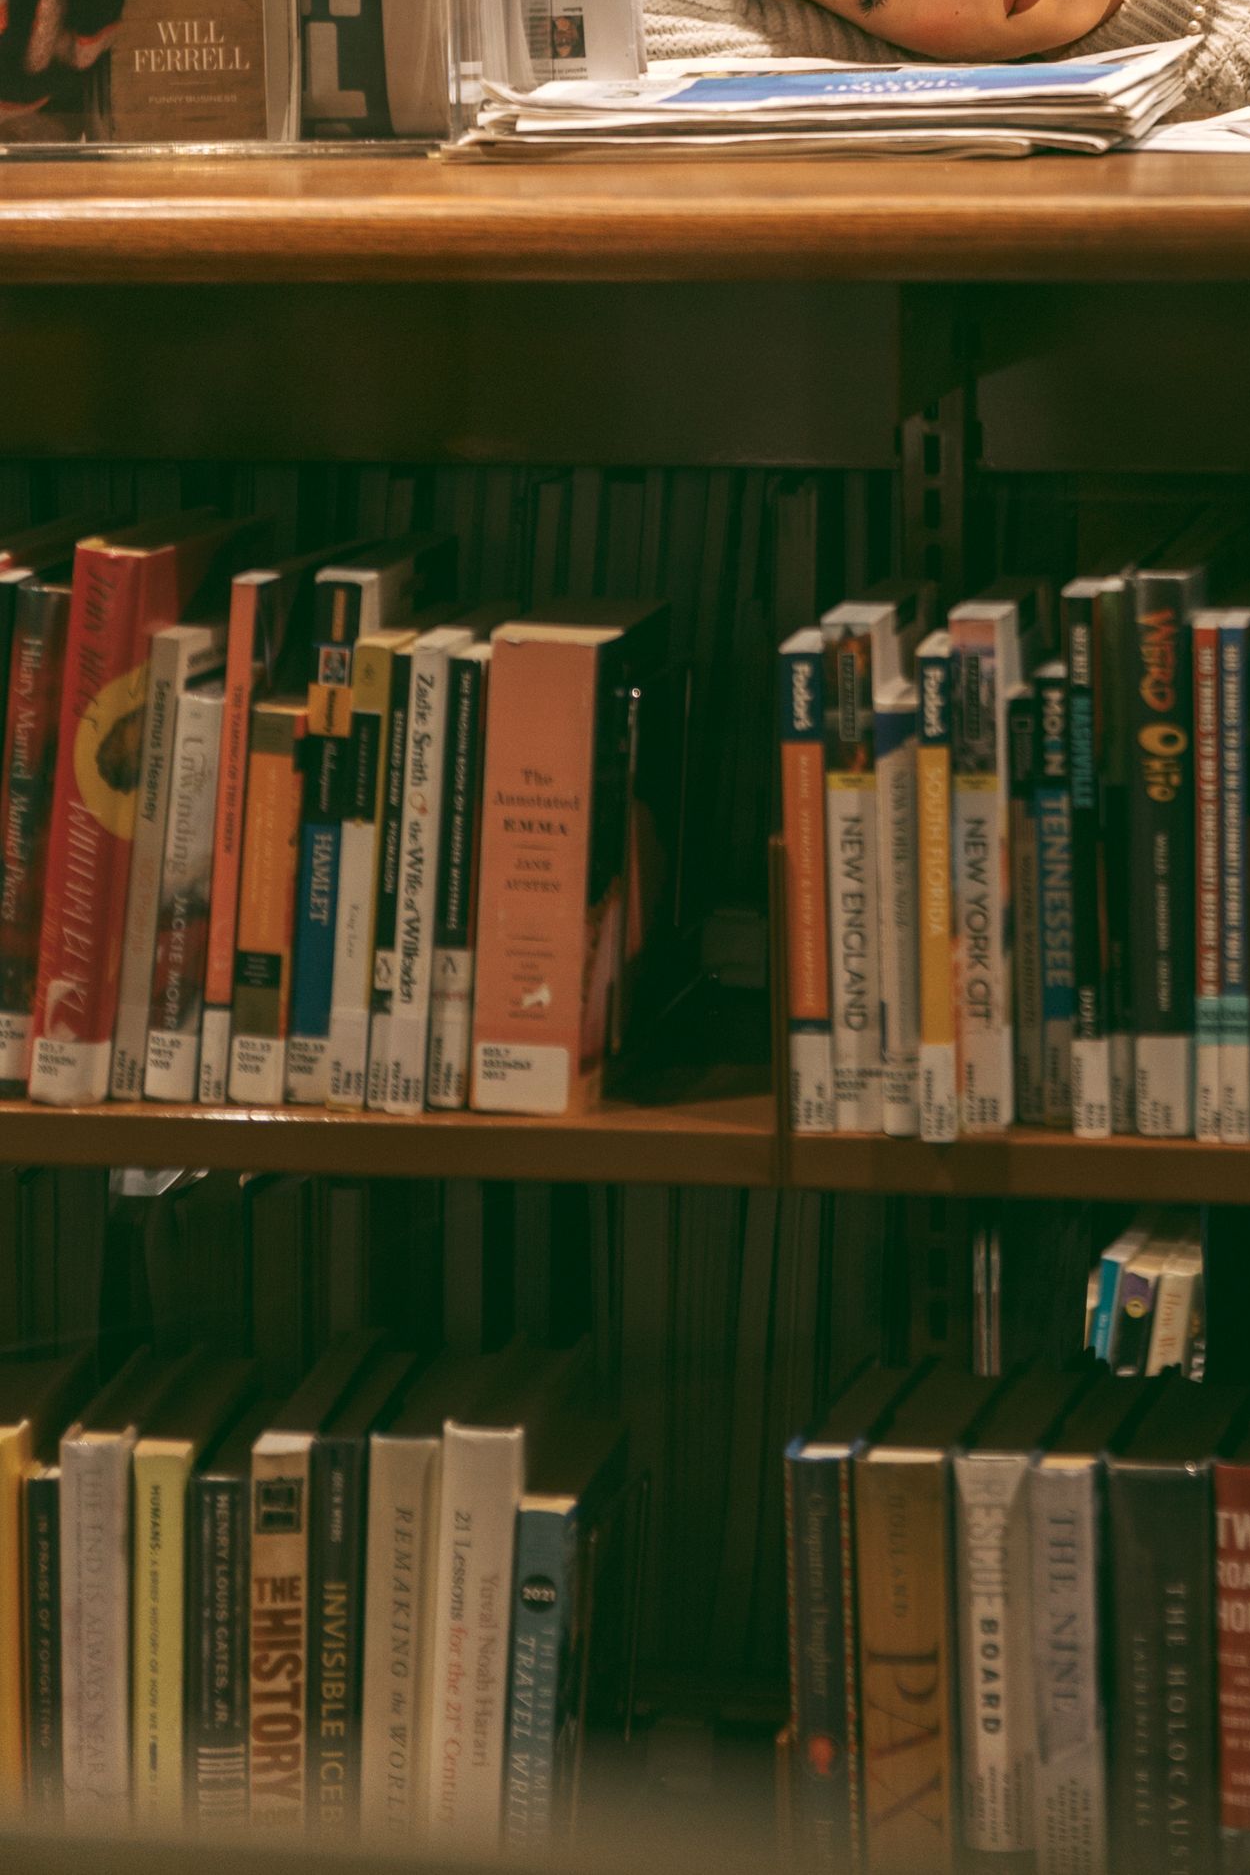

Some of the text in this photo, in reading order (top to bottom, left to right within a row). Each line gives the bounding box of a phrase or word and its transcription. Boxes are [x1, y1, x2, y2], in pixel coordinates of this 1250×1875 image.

[133, 46, 250, 73] FERRELL
[157, 20, 225, 45] WILL
[148, 93, 237, 104] FUNNY BUSINESS
[12, 637, 43, 779] Hilary Mantel
[457, 698, 470, 753] PENGUIN
[792, 664, 813, 731] Fodor's
[924, 668, 944, 737] Fodor's
[1201, 678, 1216, 733] THINGS
[1223, 675, 1238, 725] THINGS
[141, 679, 171, 823] Seamus Heaney
[411, 674, 435, 787] Zadie Smith
[1043, 687, 1065, 776] MOON
[1071, 696, 1093, 808] NASHVILLE
[1201, 737, 1216, 755] TO
[1223, 731, 1238, 748] TO
[1223, 752, 1238, 771] DO
[454, 756, 467, 792] BOOK
[520, 768, 553, 788] The
[1201, 759, 1216, 778] DO
[1201, 783, 1216, 799] IN
[1223, 775, 1238, 789] IN
[408, 821, 424, 845] the
[503, 818, 568, 837] EMMA
[926, 765, 944, 938] SOUTH FLORIDA
[1201, 804, 1216, 889] CINCINNATI
[1223, 792, 1238, 874] CINCINNATI
[308, 833, 333, 925] HAMLET
[405, 846, 424, 898] Wife
[965, 818, 991, 967] NEW YORK
[1042, 794, 1073, 989] TENNESSEE
[1223, 877, 1238, 927] BEFORE
[168, 893, 188, 963] JACKIE
[841, 816, 869, 1031] NEW ENGLAND
[1201, 893, 1216, 947] BEFORE
[1223, 931, 1238, 959] YOU
[1201, 951, 1216, 981] YOU
[38, 1541, 49, 1601] PRAISE
[253, 1575, 302, 1604] THE
[522, 1587, 556, 1602] 2021
[39, 1609, 50, 1631] OF
[213, 1494, 229, 1729] HENRY LOUIS GATES, JR.
[391, 1506, 416, 1713] REMAKING the
[1049, 1510, 1081, 1712] THE NINE
[1166, 1584, 1187, 1646] THE
[320, 1581, 347, 1738] INVISIBLE
[436, 1510, 471, 1823] 21 Lessons for the Century
[472, 1573, 500, 1766] Yuval Noah Harari
[512, 1635, 536, 1739] TRAVEL
[536, 1627, 556, 1742] THE BEST
[980, 1618, 1000, 1735] BOARD
[39, 1639, 51, 1748] FORGETTING
[252, 1608, 303, 1802] HISTORY
